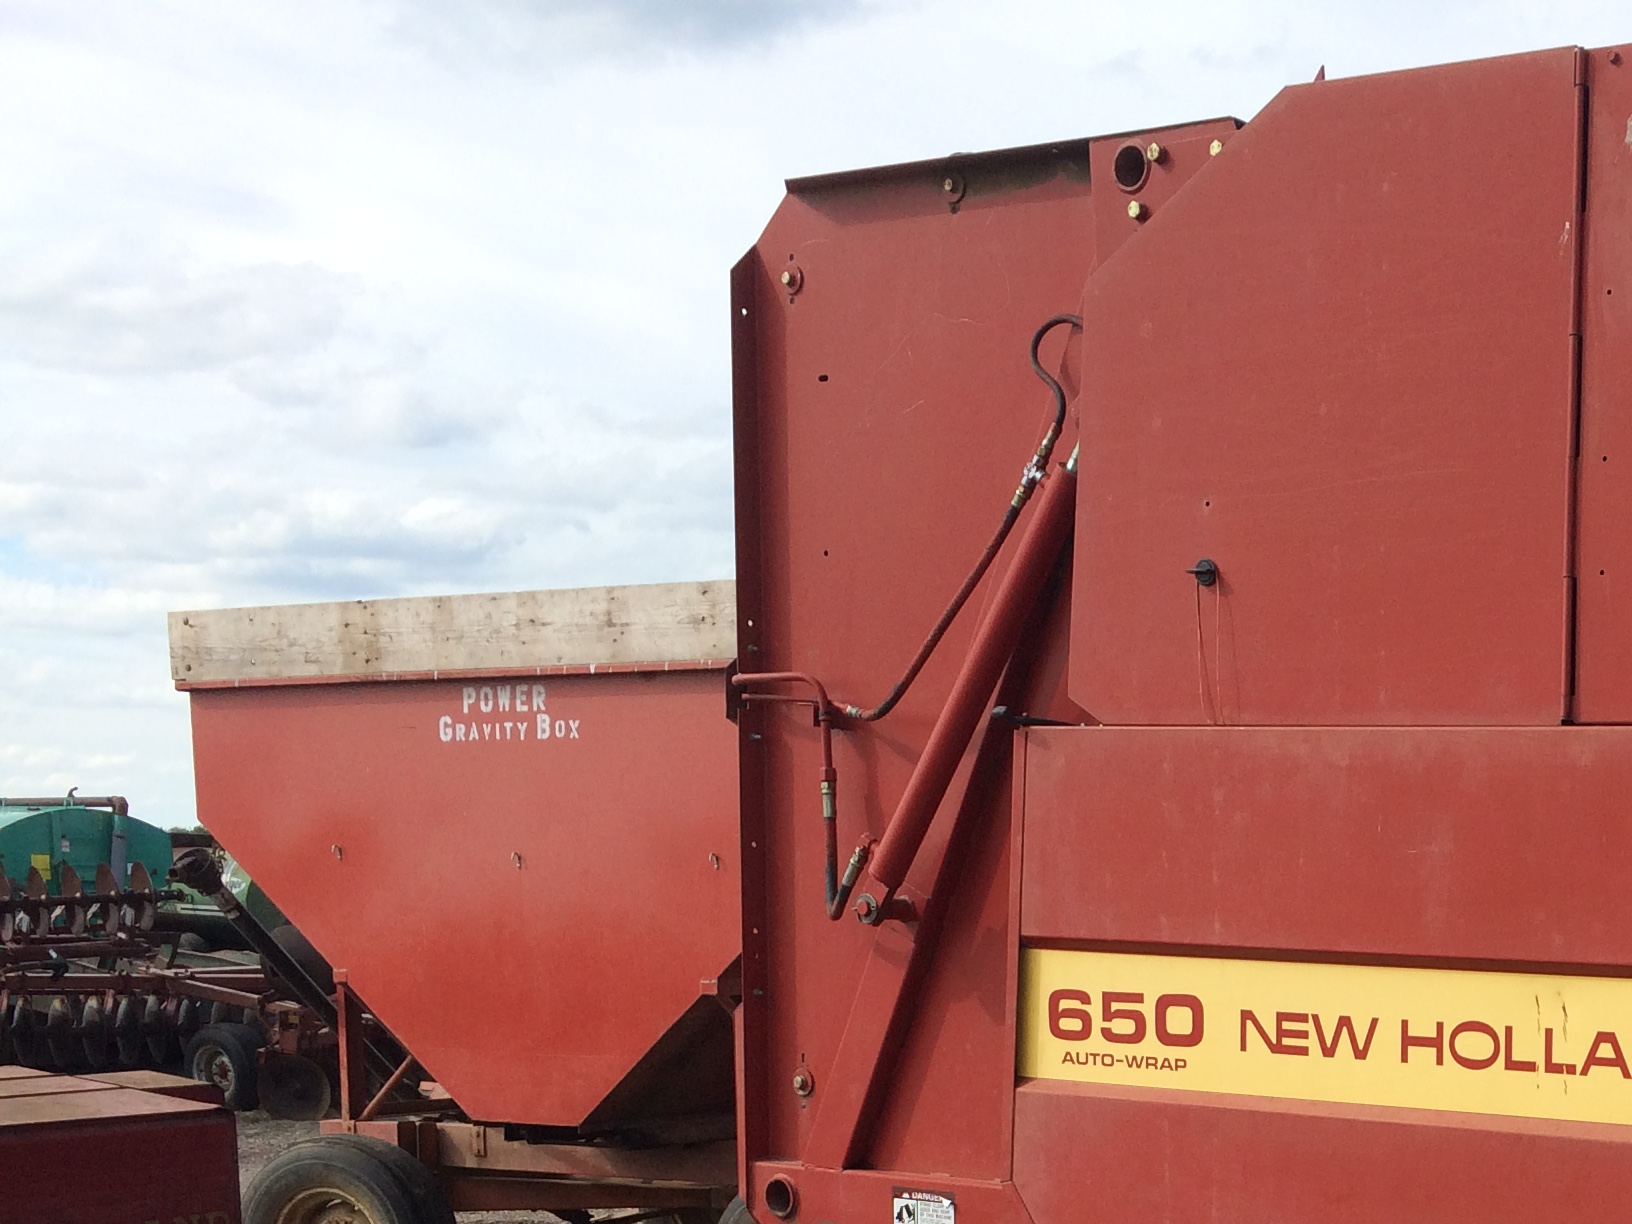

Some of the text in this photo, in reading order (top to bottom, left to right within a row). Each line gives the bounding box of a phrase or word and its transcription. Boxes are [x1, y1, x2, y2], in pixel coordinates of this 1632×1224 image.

[462, 683, 547, 714] POWER
[438, 713, 581, 743] GRAVITY BOX
[1046, 987, 1205, 1048] 650
[1239, 1008, 1381, 1061] NEW
[1061, 1050, 1188, 1073] AUTO-WRAP
[911, 1192, 942, 1201] DANGE
